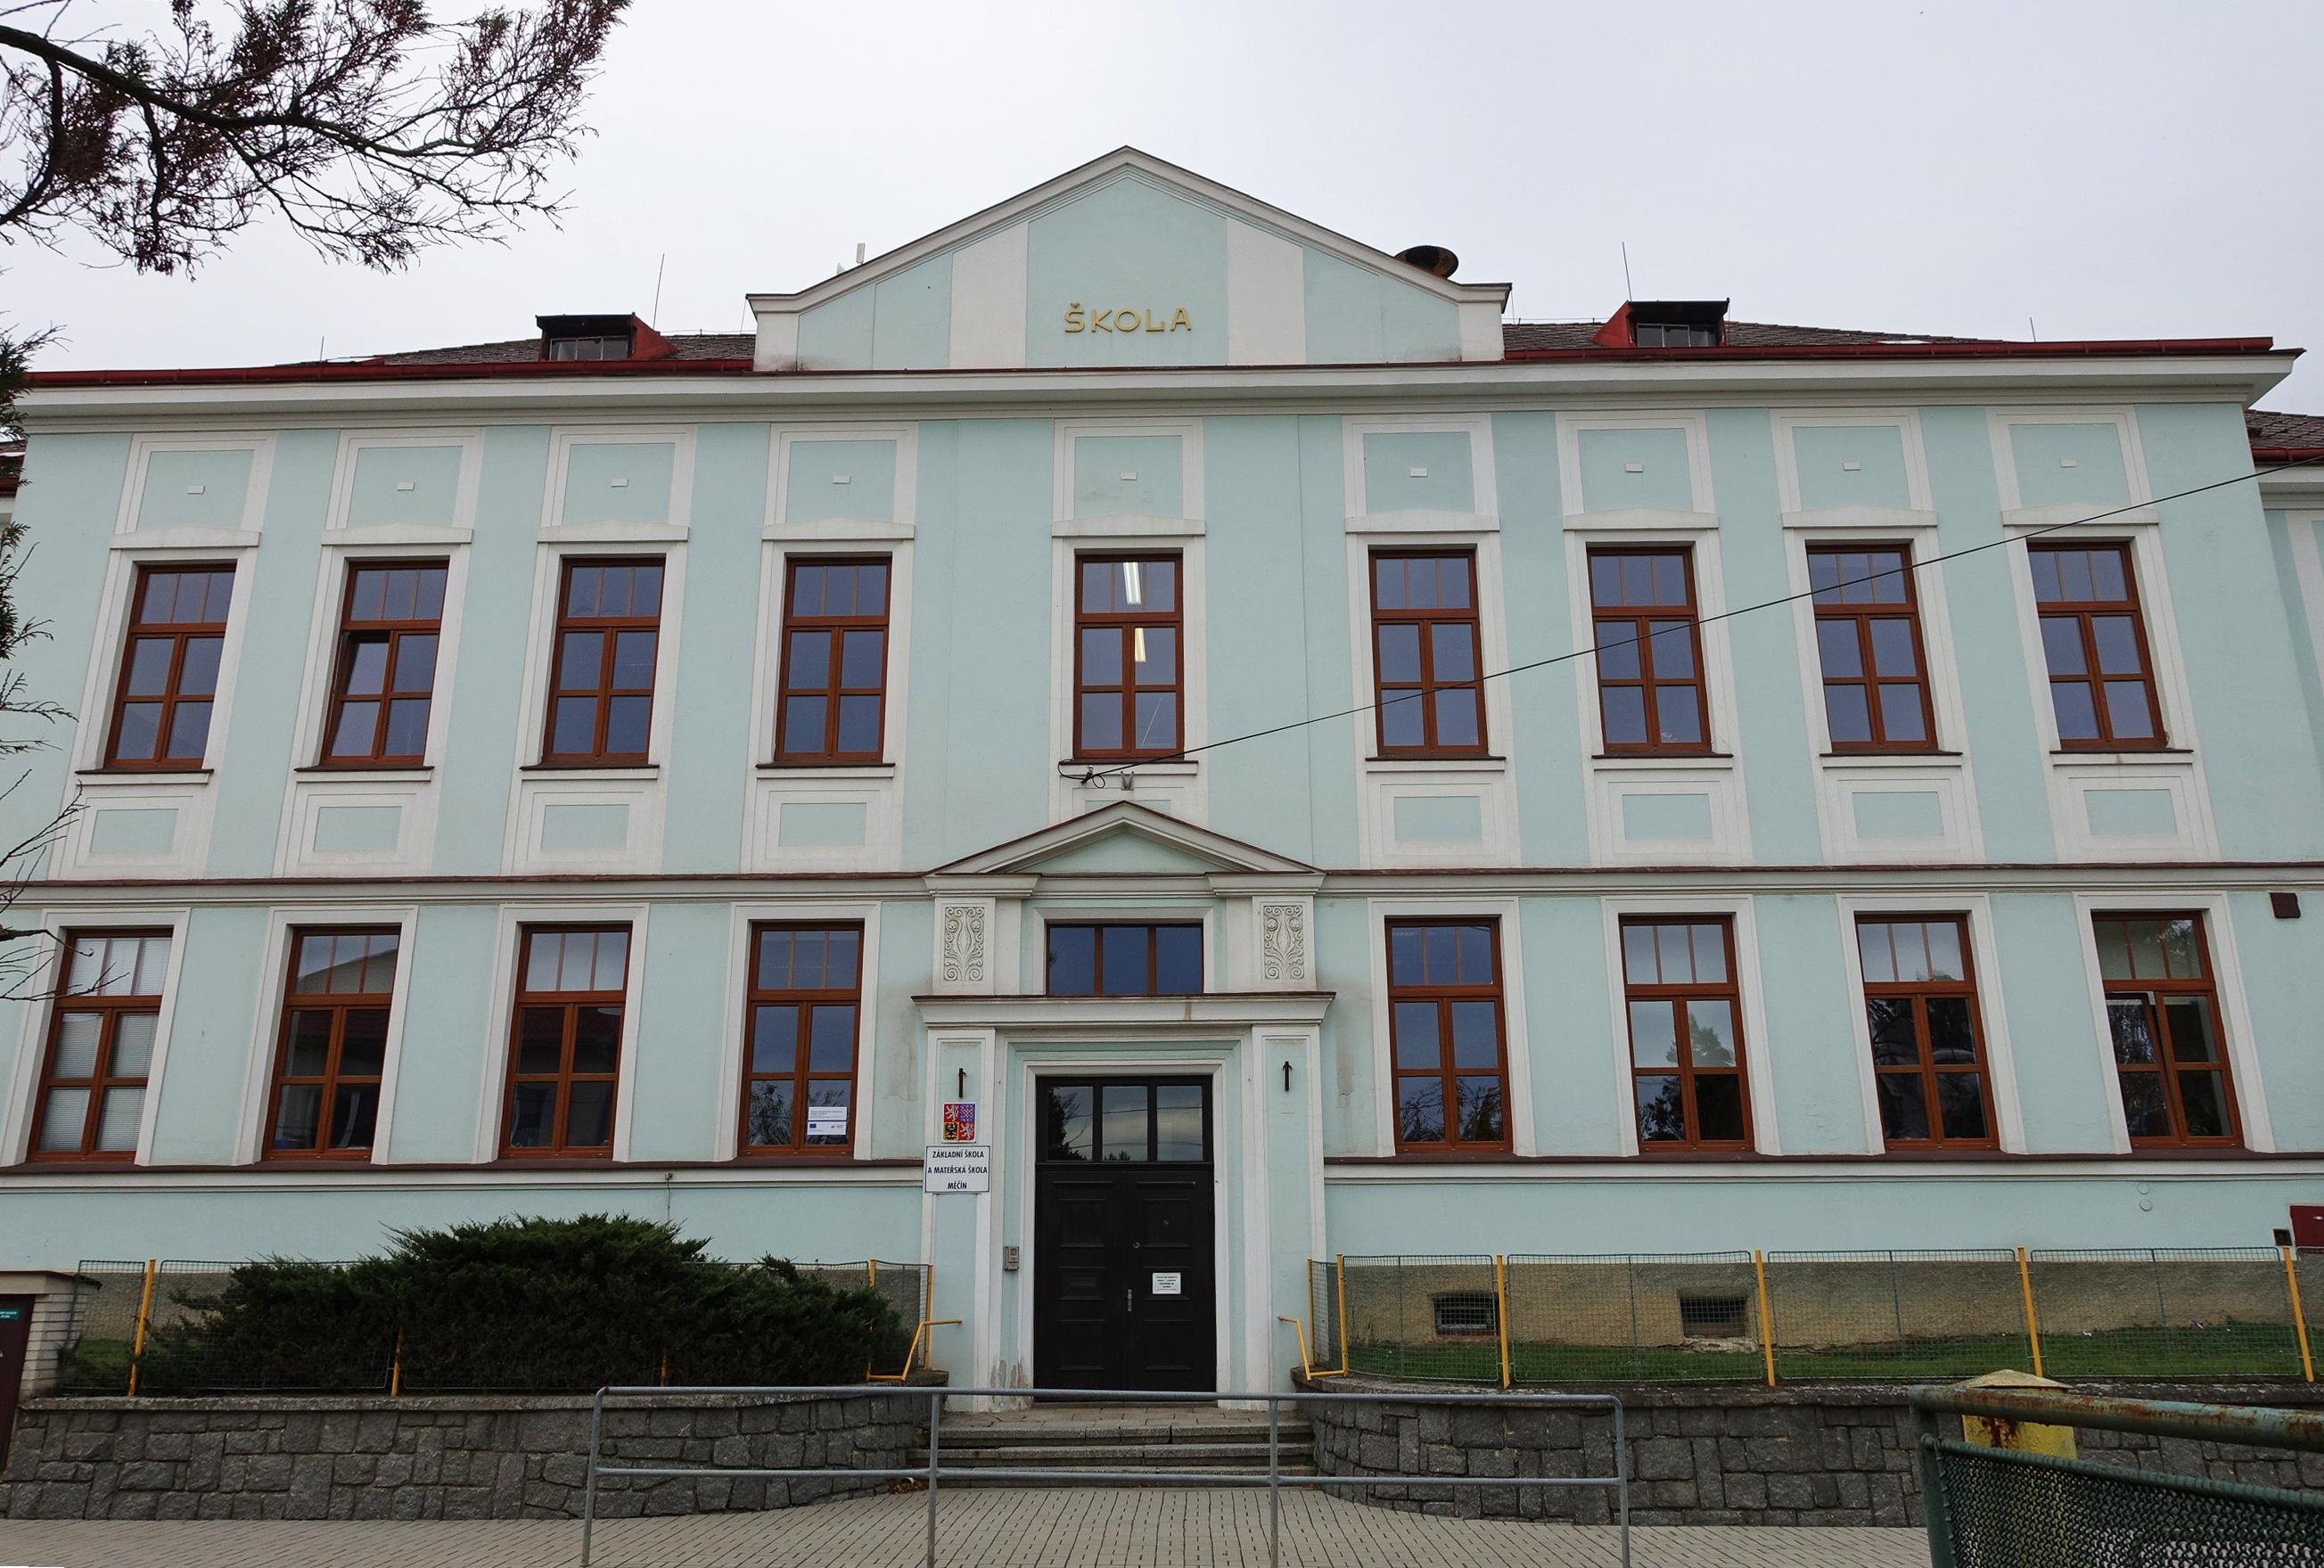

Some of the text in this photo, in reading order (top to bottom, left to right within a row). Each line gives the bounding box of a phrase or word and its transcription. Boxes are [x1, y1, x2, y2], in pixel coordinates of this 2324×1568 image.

[1064, 302, 1192, 332] ŠKOLA
[932, 1149, 984, 1158] ZÁKLADNÍ ŠKOLA
[928, 1164, 988, 1174] A MATEŘSKÁ ŠKOLA
